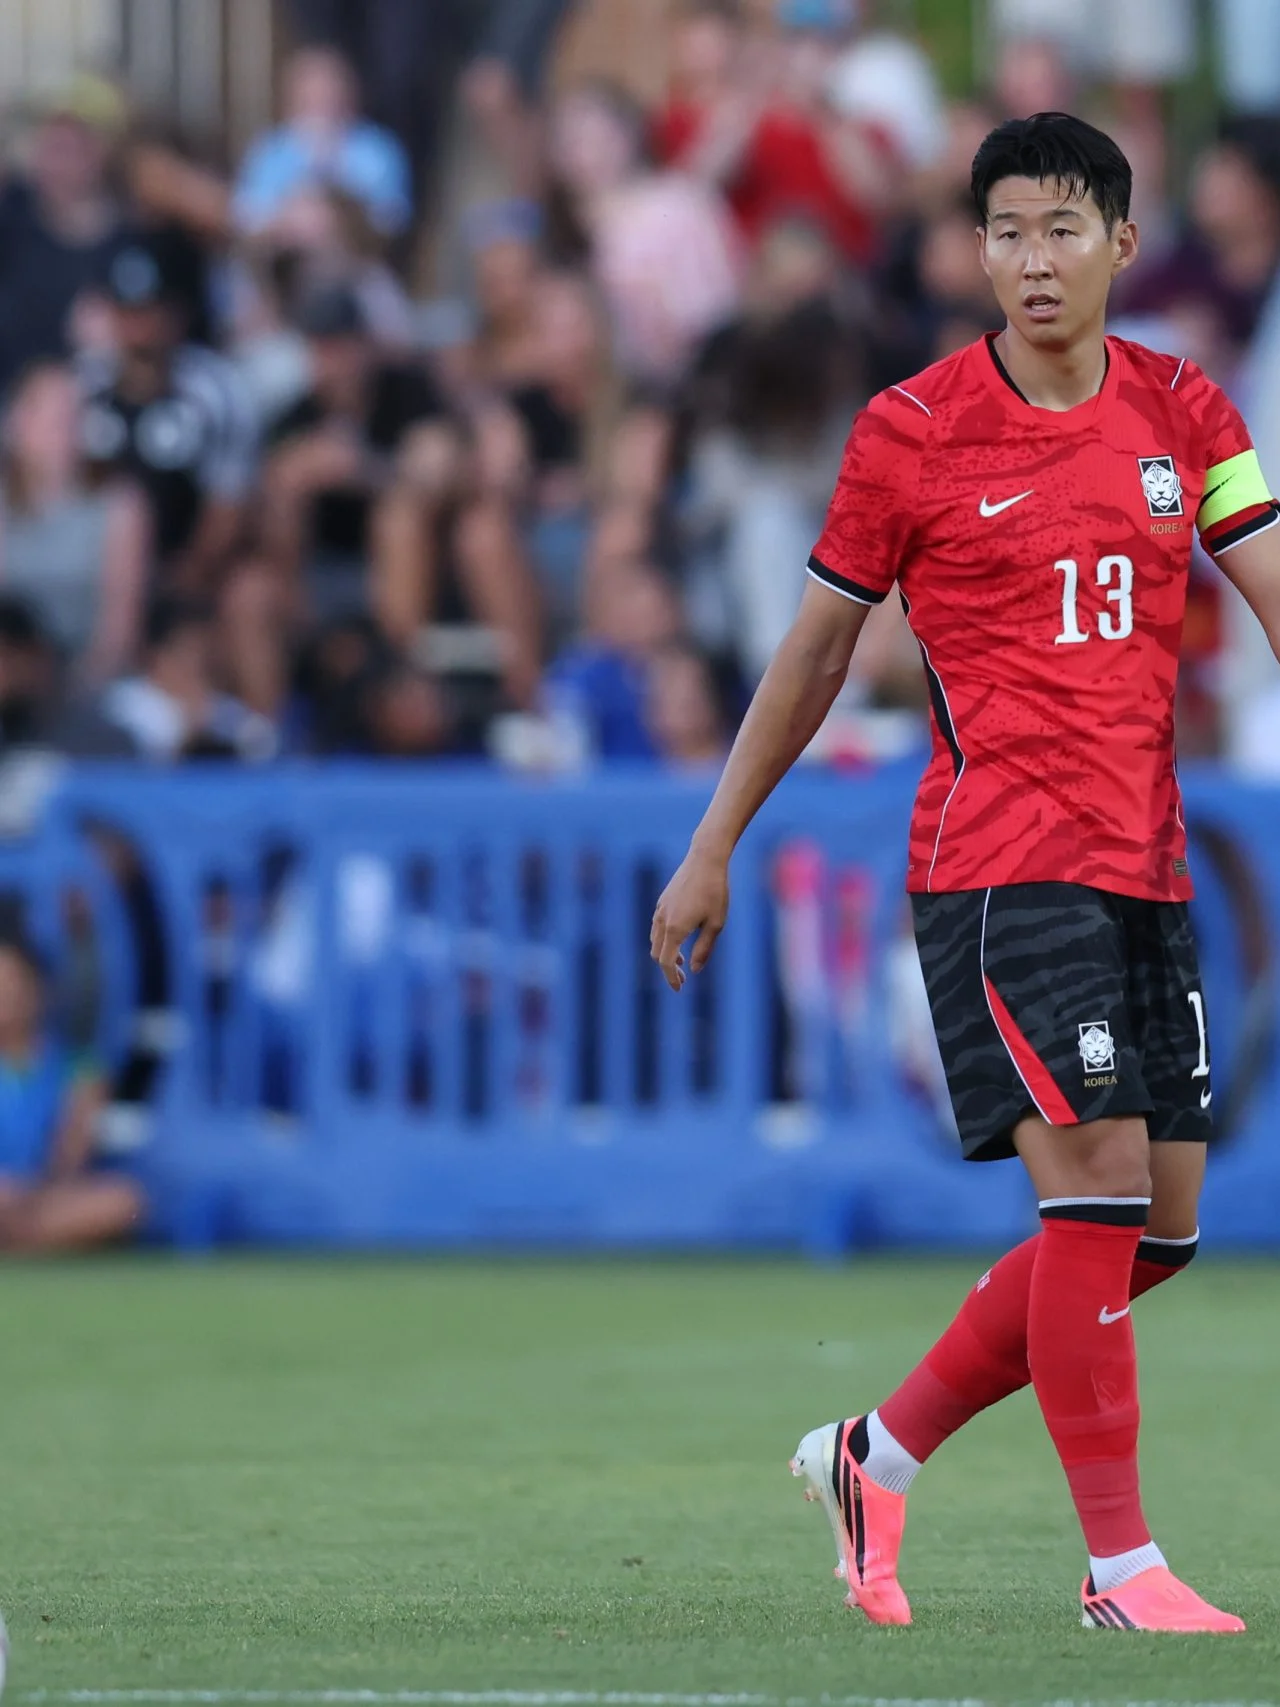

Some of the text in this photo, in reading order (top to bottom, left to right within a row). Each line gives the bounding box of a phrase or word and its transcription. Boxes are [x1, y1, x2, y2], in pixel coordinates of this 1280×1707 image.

[1150, 522, 1184, 535] KOREA
[1054, 555, 1134, 646] 13
[1084, 1075, 1118, 1088] KOREA
